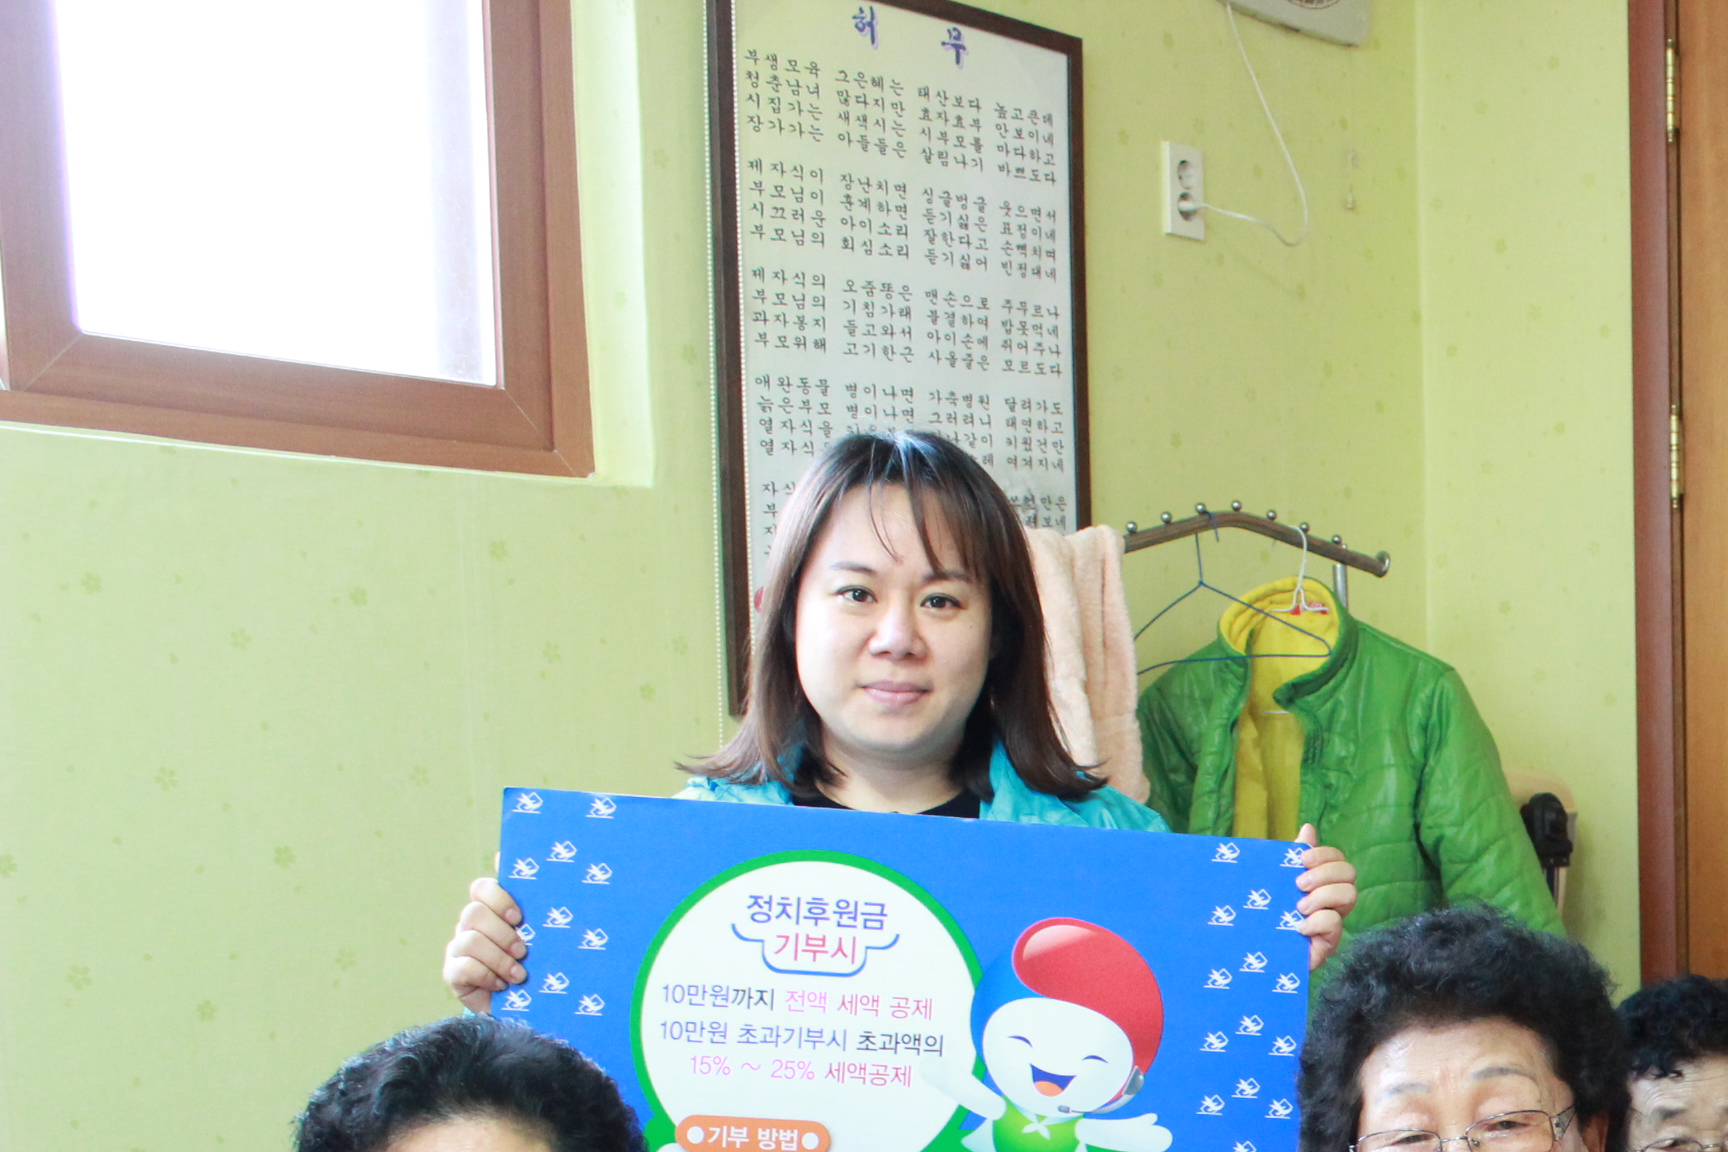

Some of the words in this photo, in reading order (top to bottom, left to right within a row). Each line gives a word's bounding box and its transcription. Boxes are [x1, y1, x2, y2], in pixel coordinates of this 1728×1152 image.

[760, 438, 830, 456] 열자식
[747, 894, 888, 931] 정치후원금
[774, 932, 857, 965] 기부시
[662, 983, 775, 1011] 10만원까지
[785, 990, 828, 1014] 전액
[837, 993, 880, 1017] 세액
[889, 995, 933, 1020] 공제
[660, 1020, 728, 1045] 10만원
[736, 1023, 848, 1052] 초과기부시
[856, 1030, 945, 1057] 초과액의
[690, 1055, 731, 1076] 15%
[770, 1059, 815, 1081] 25%
[824, 1061, 912, 1088] 세액공제
[707, 1125, 749, 1148] 기부
[757, 1128, 799, 1151] 방법
